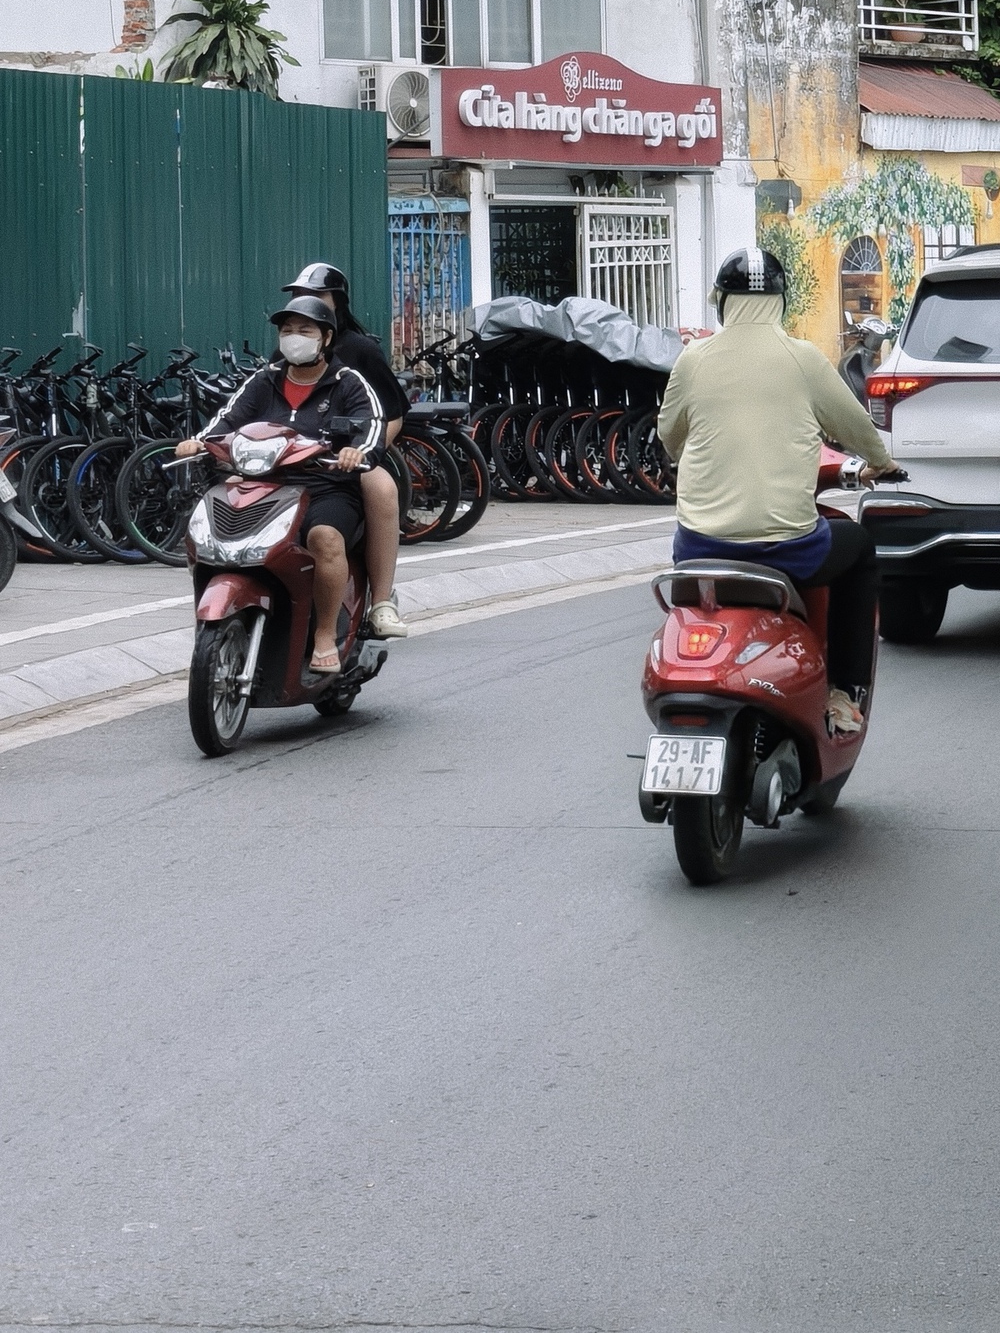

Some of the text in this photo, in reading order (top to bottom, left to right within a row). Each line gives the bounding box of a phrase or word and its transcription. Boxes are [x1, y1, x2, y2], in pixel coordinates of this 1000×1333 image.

[458, 84, 718, 148] Cửa hàng chăn ga gối
[657, 740, 713, 764] 29-AF
[650, 766, 715, 790] 141.71
